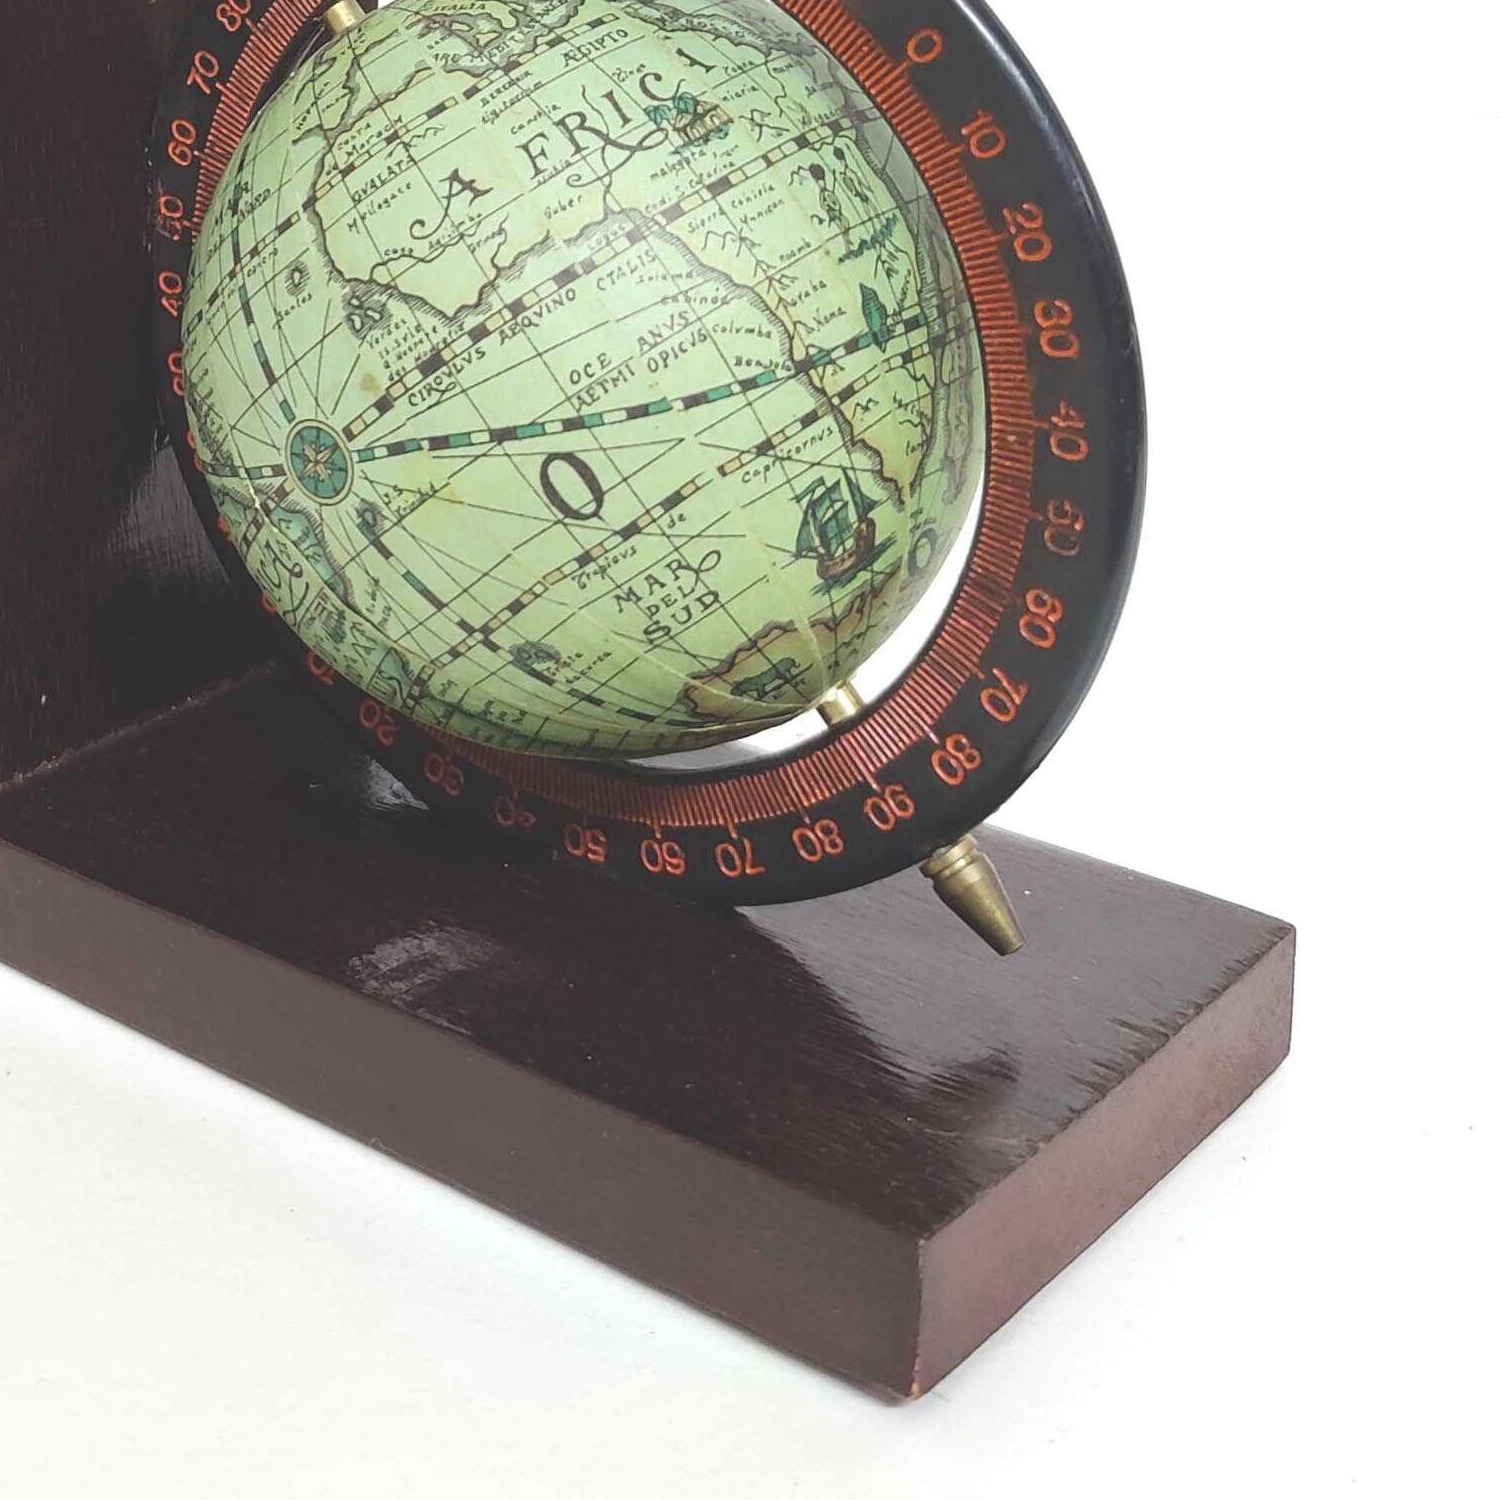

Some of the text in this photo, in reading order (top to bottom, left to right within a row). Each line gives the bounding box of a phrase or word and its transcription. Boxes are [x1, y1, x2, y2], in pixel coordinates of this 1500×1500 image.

[906, 28, 943, 64] 0
[187, 50, 220, 93] 70
[167, 119, 197, 167] 60
[961, 110, 1006, 159] 10
[1004, 201, 1052, 261] 20
[1034, 300, 1080, 357] 30
[1049, 403, 1089, 461] 40
[1043, 500, 1084, 556] 50
[1019, 588, 1063, 649] 60
[981, 668, 1028, 722] 70
[931, 734, 981, 786] 80
[863, 785, 915, 831] 90
[640, 840, 687, 876] 60
[714, 841, 765, 878] 70
[791, 820, 844, 862] 80
